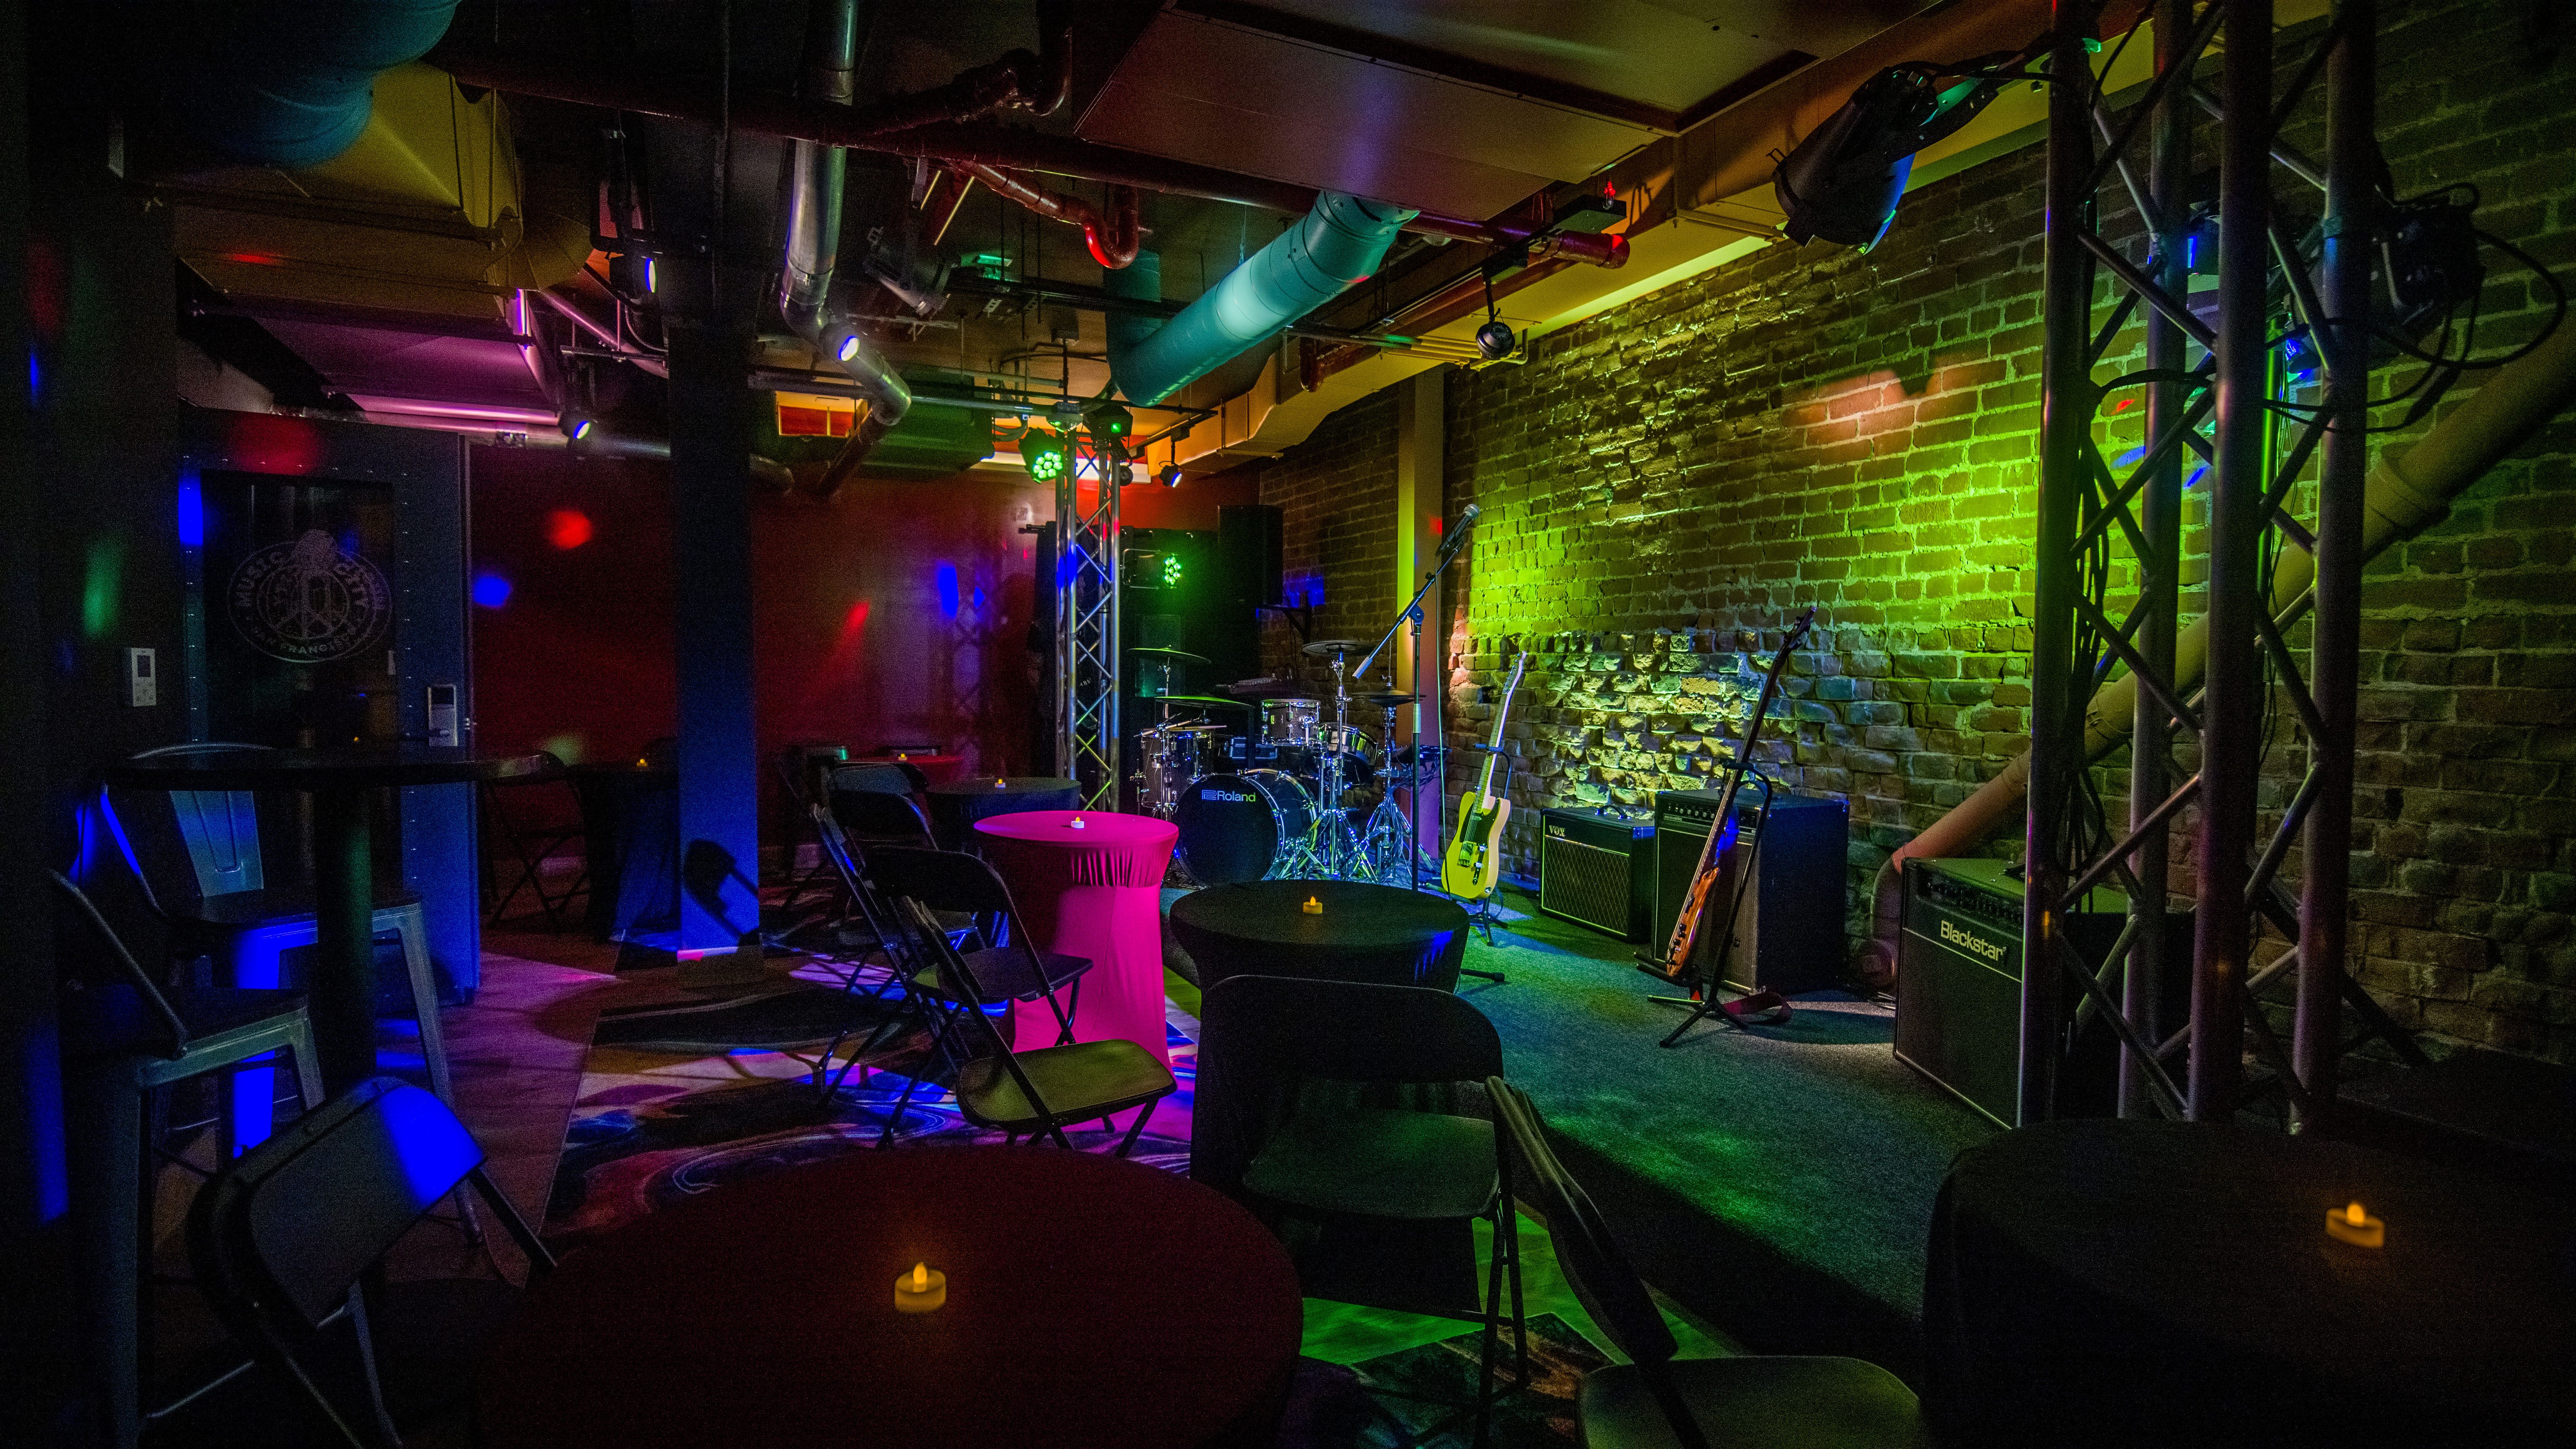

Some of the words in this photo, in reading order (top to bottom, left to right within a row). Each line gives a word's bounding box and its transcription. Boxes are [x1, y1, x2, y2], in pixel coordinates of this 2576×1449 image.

[235, 551, 283, 607] MUSIC
[333, 561, 369, 608] CITY
[1217, 790, 1256, 802] Roland
[1549, 825, 1566, 837] VOX
[1940, 920, 2004, 961] Blackstar
